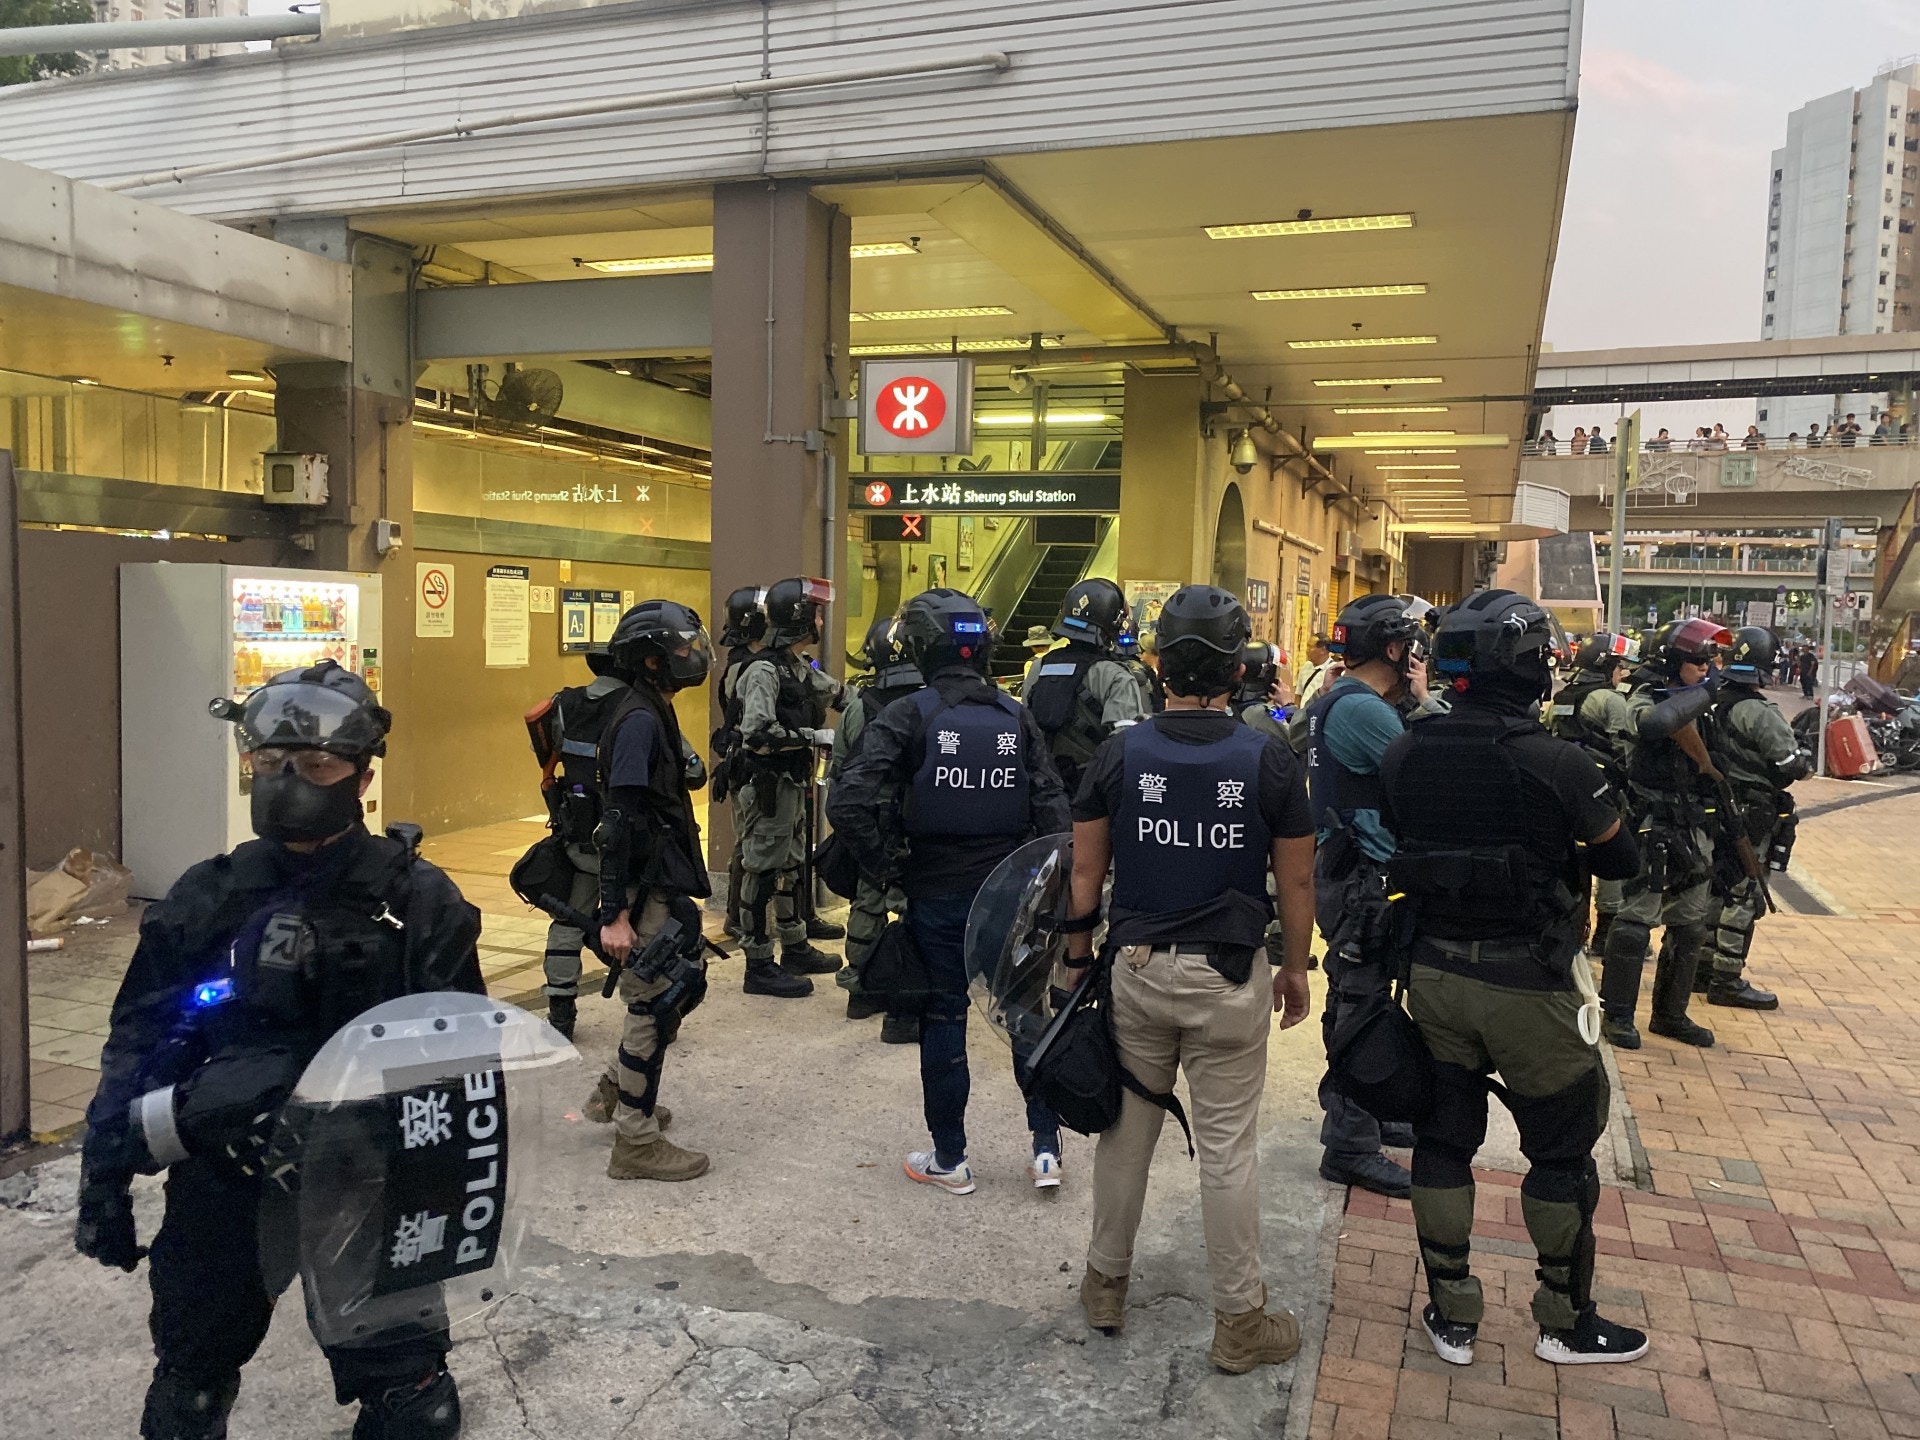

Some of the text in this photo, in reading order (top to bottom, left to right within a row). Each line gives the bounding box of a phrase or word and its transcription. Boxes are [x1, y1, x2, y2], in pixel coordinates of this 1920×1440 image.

[900, 483, 1076, 505] 上水站 Sheung Shui Station
[935, 766, 1017, 789] POLICE
[1137, 816, 1245, 849] POLICE
[455, 1069, 499, 1265] POLICE
